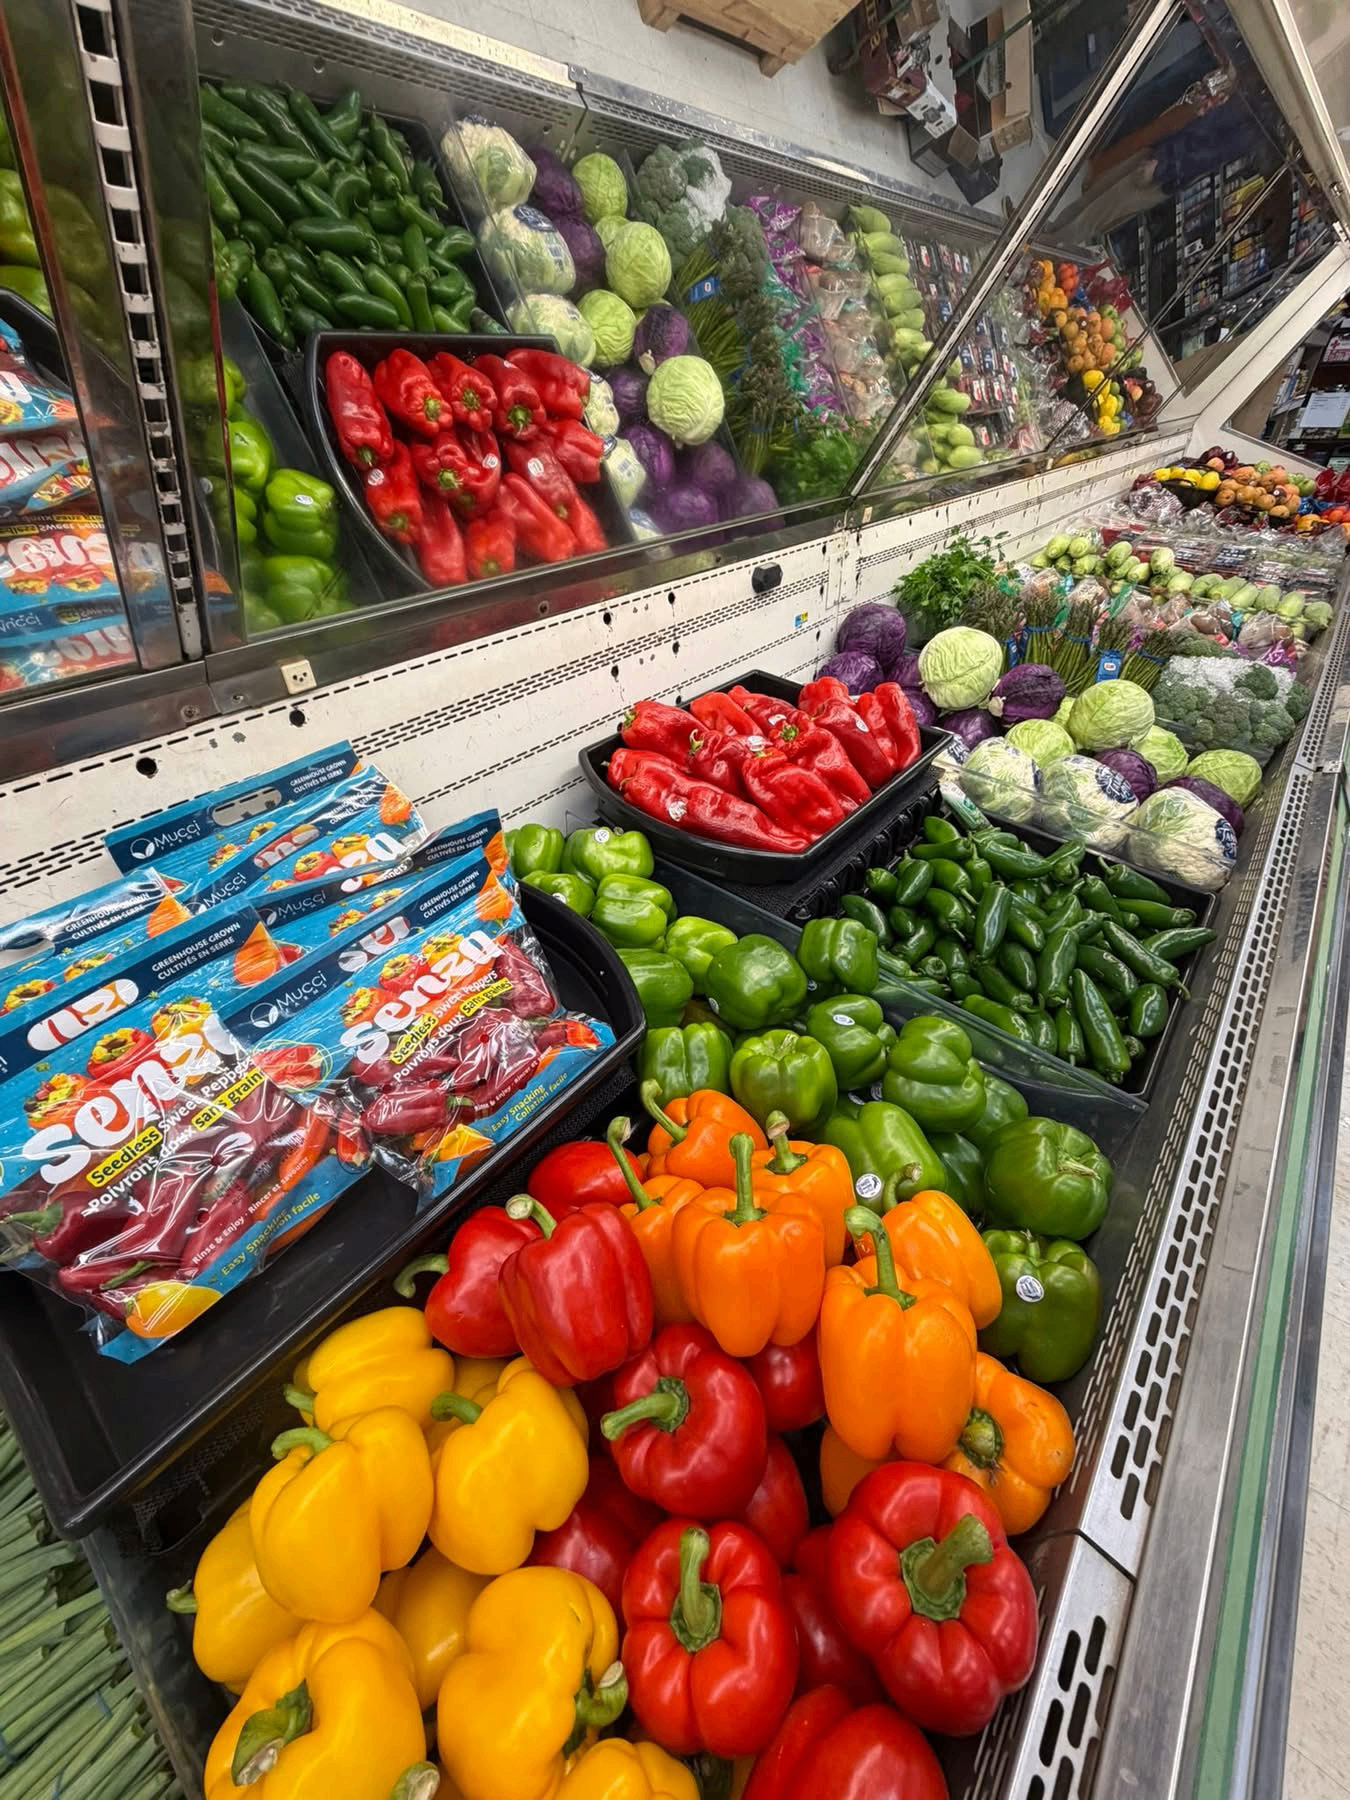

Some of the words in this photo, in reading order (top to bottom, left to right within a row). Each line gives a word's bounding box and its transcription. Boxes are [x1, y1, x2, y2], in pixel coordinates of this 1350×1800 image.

[327, 760, 347, 773] GROWN
[153, 820, 201, 848] Mucci
[426, 839, 467, 854] GREENHOUSE
[467, 827, 488, 841] GROWN
[203, 872, 247, 907] Mucci
[277, 889, 327, 917] Mucci
[419, 884, 458, 912] GREENHOUSE
[458, 870, 480, 888] GROWN
[423, 898, 451, 919] CULTIVÉS
[450, 893, 459, 902] EN
[459, 882, 476, 896] SERRE
[151, 933, 208, 972] GREENHOUSE
[208, 922, 241, 943] GROWN
[157, 953, 198, 980] CULTIVÉS
[198, 947, 208, 957] EN
[208, 936, 235, 952] SERRE
[276, 970, 327, 1010] Mucci
[340, 930, 505, 1064] senza
[393, 1015, 438, 1062] Seedless
[461, 970, 498, 998] Peppers
[393, 1038, 440, 1082] Poivrons
[437, 1012, 465, 1039] doux
[463, 996, 485, 1014] sans
[515, 1090, 549, 1122] Collation
[548, 1072, 568, 1093] facile
[84, 1155, 160, 1215] Poivrons
[193, 1099, 228, 1128] sans
[227, 1070, 264, 1105] grain
[491, 1113, 510, 1132] Easy
[90, 1129, 161, 1186] Seedless
[290, 1191, 321, 1214] facile
[192, 1242, 216, 1264] Rinse
[215, 1235, 224, 1244] &
[223, 1216, 245, 1237] Enjoy
[247, 1191, 272, 1214] Rincer
[271, 1183, 281, 1192] et
[221, 1251, 247, 1276] Easy
